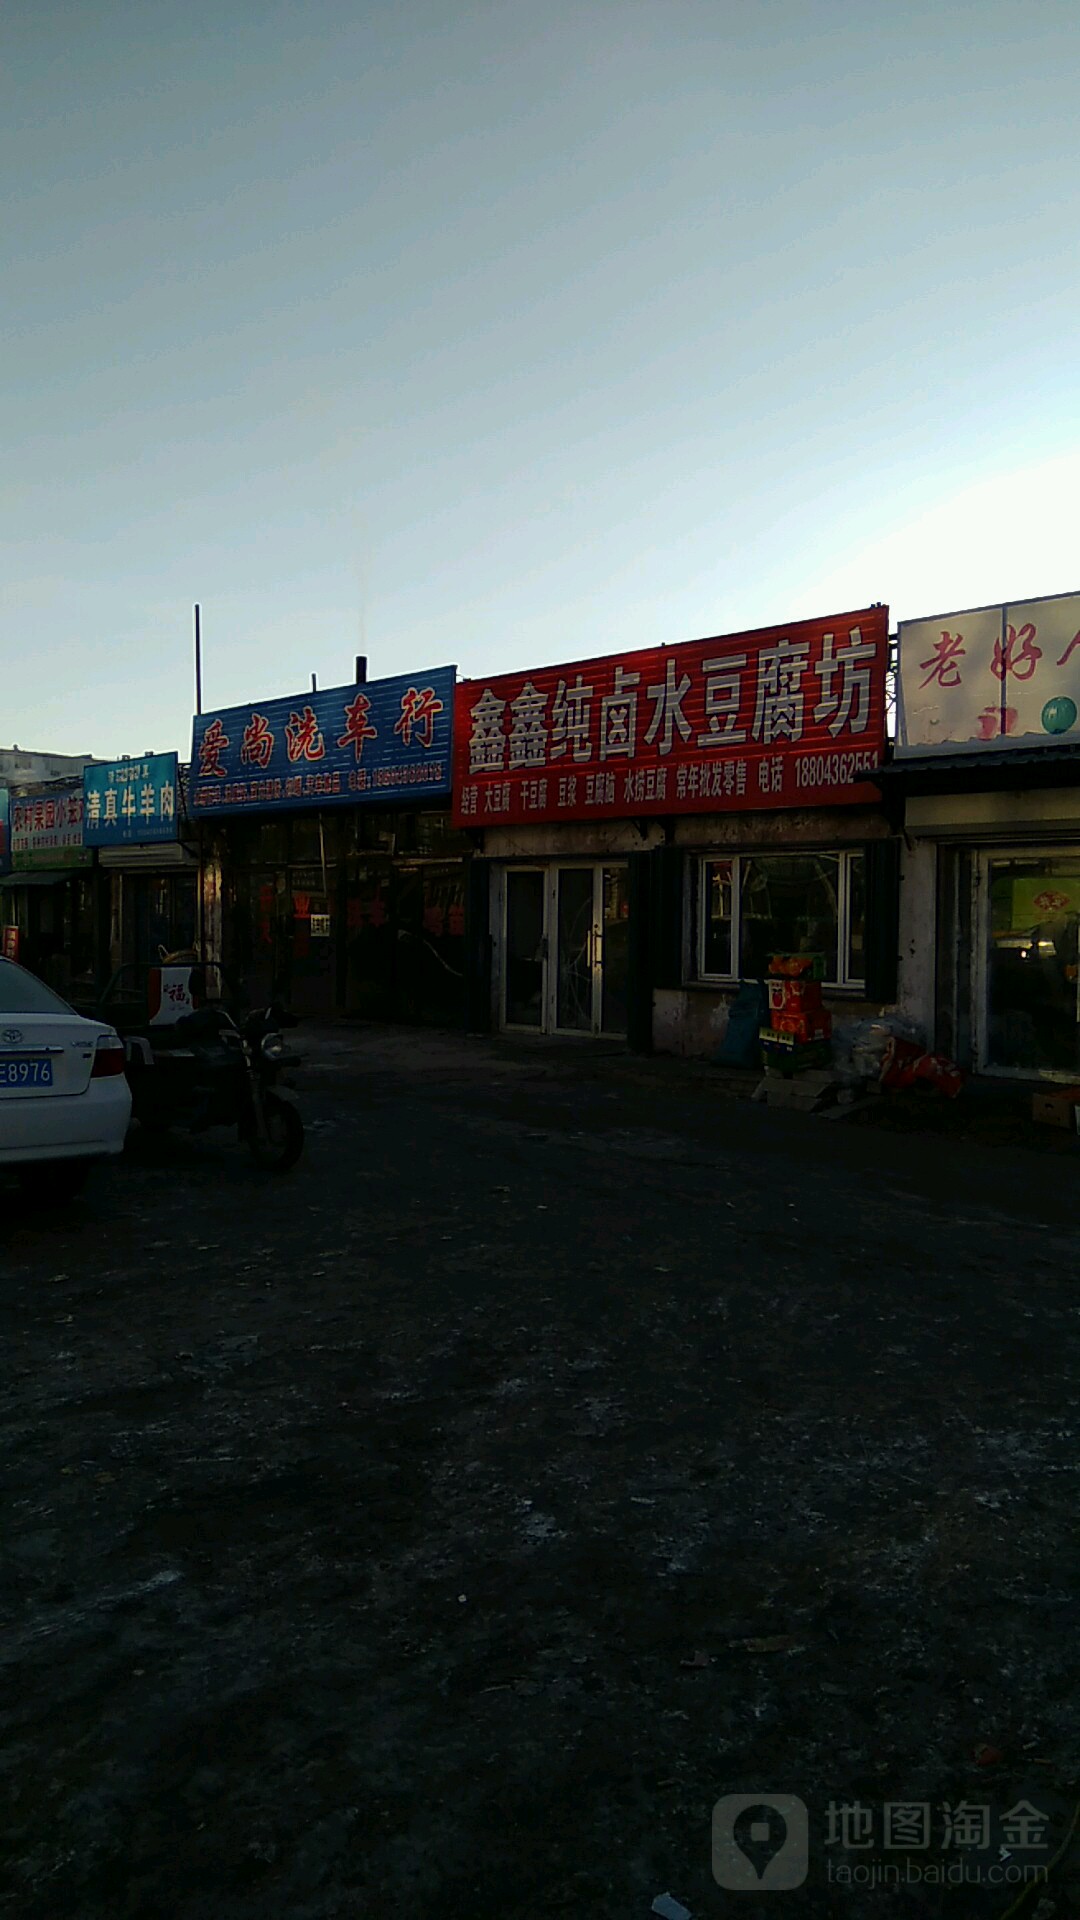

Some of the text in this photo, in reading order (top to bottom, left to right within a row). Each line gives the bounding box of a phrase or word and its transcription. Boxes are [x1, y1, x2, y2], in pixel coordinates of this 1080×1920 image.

[198, 687, 444, 777] 爱尚洗车行
[469, 626, 878, 776] 鑫鑫纯卤水豆腐坊
[87, 780, 174, 829] 清真牛羊肉
[484, 782, 511, 812] 大豆腐
[520, 778, 548, 810] 干豆腐
[558, 775, 577, 807] 豆浆
[585, 772, 615, 805] 豆腐脑
[676, 760, 747, 799] 常年批发零售
[758, 756, 784, 793] 电话
